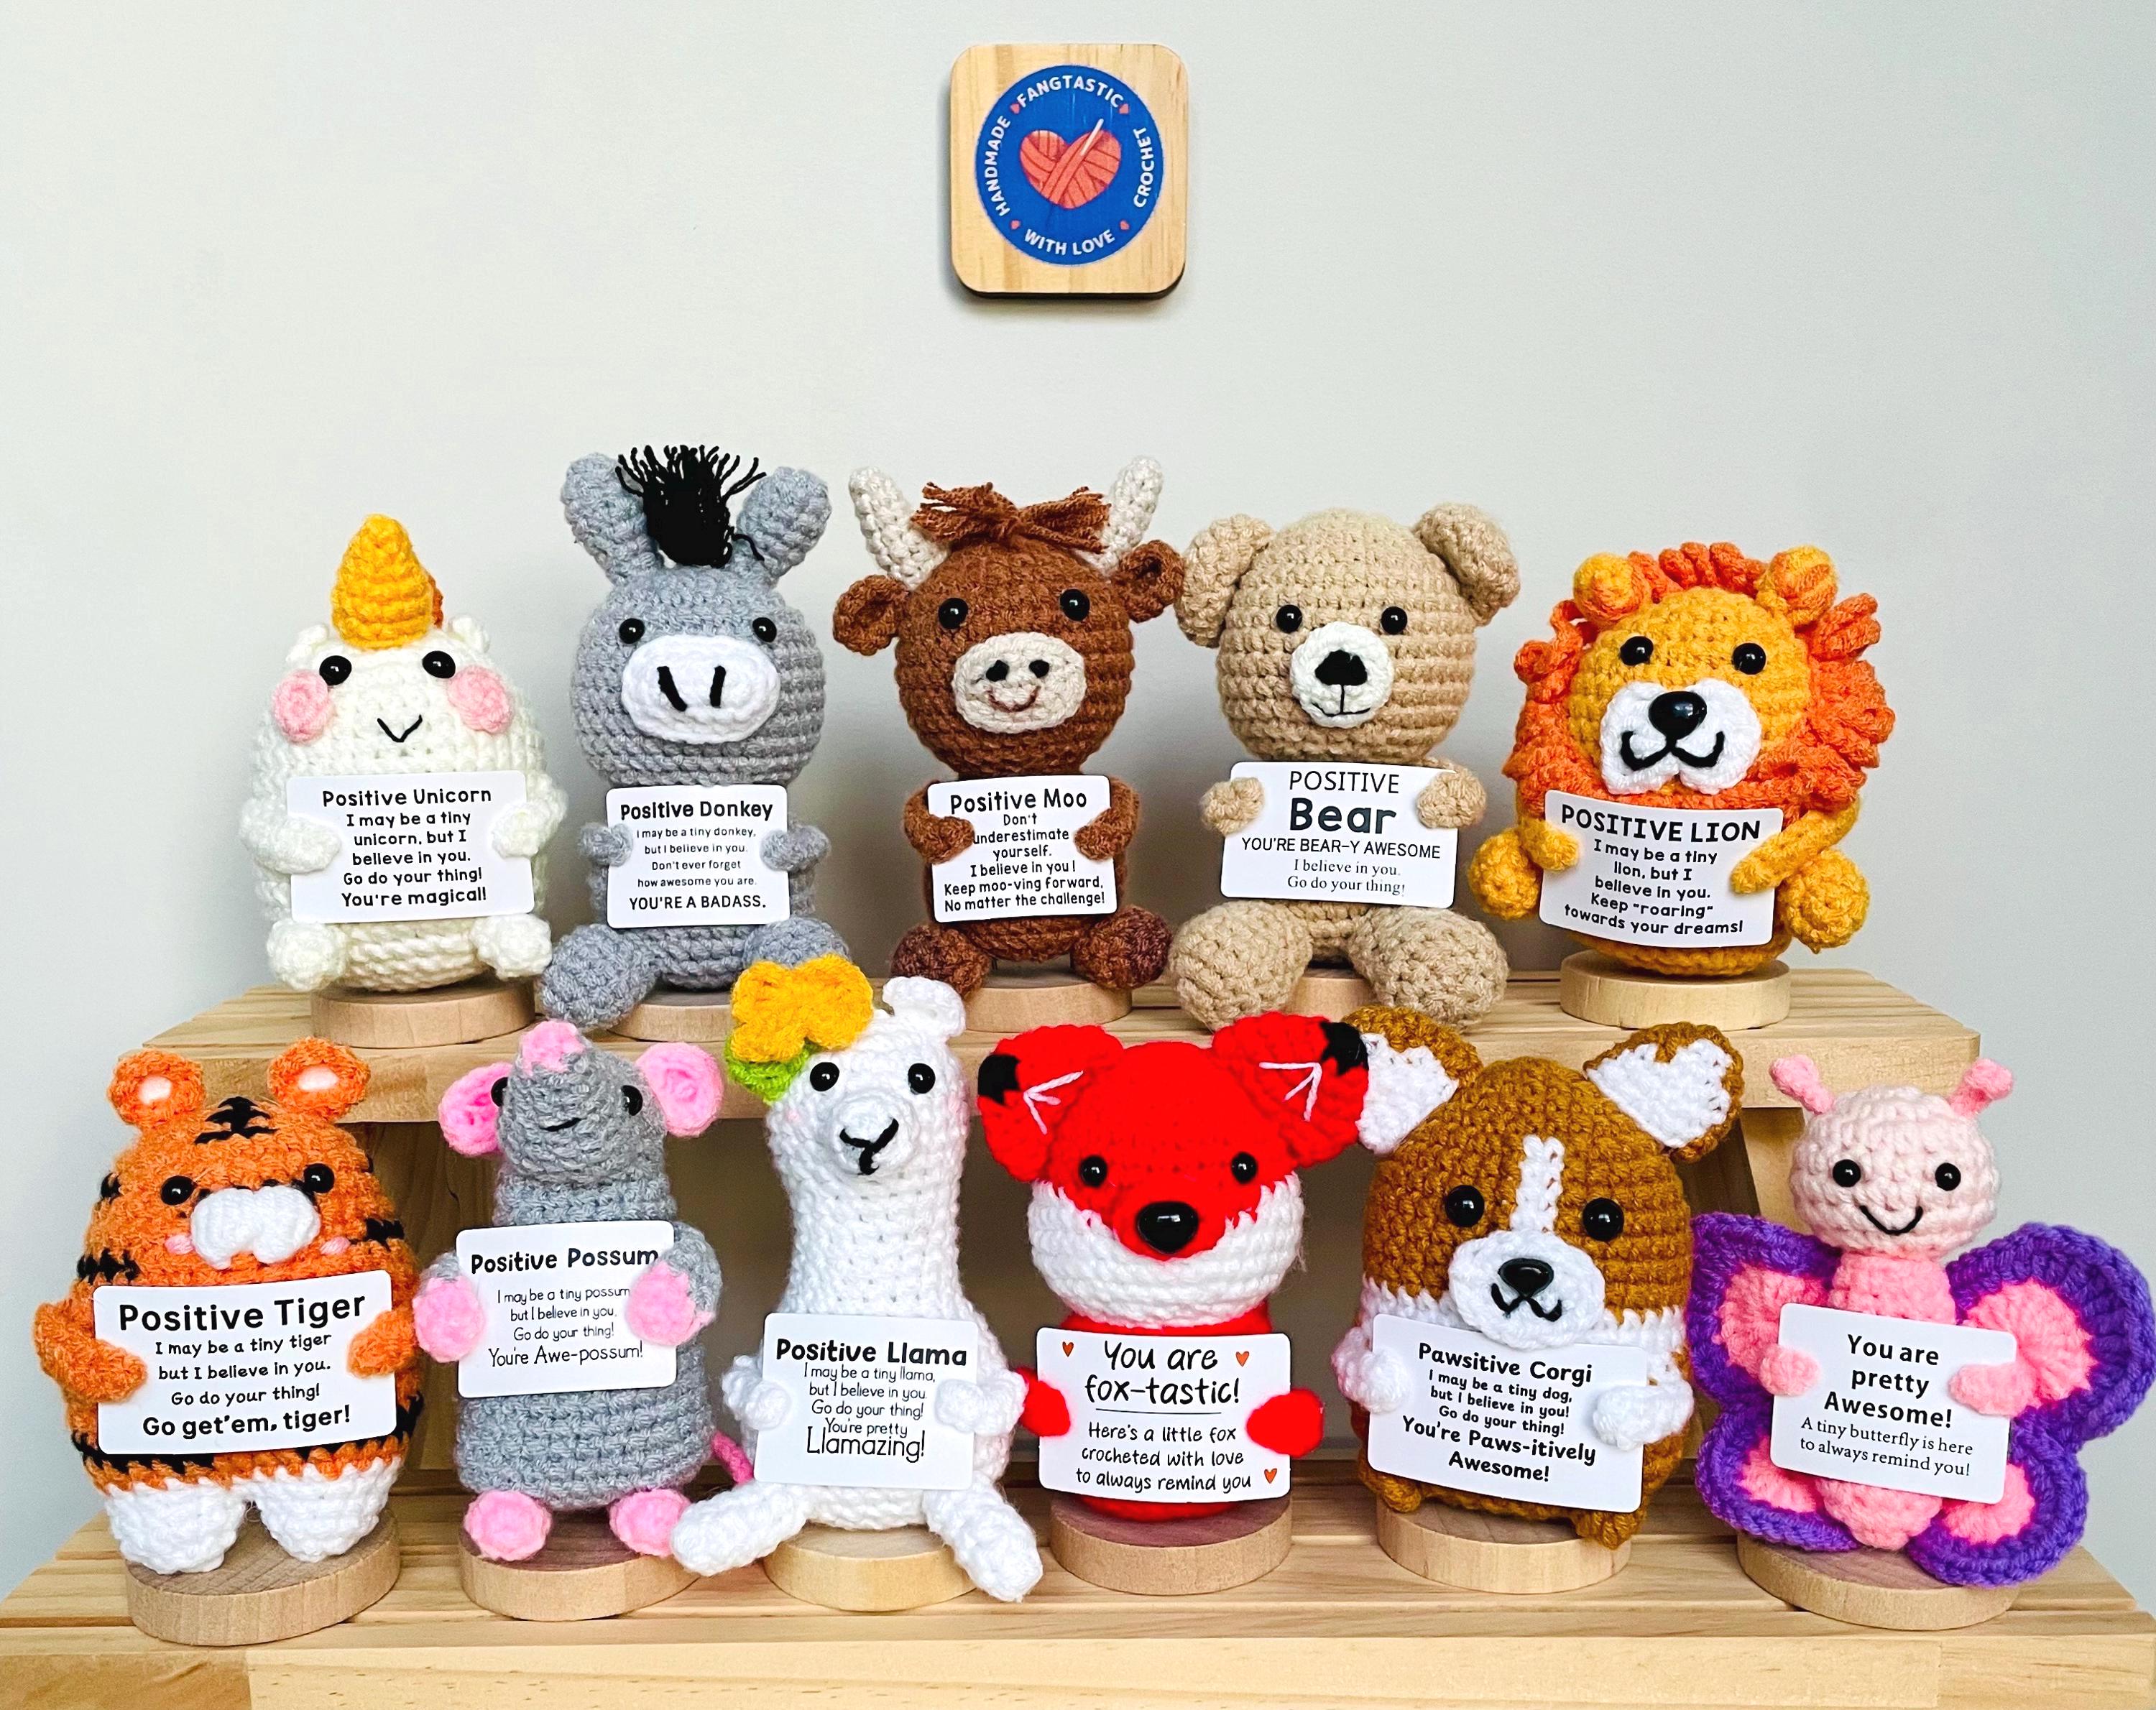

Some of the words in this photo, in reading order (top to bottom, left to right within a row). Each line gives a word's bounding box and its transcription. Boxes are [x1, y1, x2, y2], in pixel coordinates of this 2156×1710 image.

[1016, 75, 1123, 108] FANGTASTIC
[985, 116, 1010, 216] HANDMADE
[1133, 128, 1155, 208] CROCHET
[1025, 228, 1067, 255] WITH
[1072, 229, 1115, 255] LOVE
[1289, 770, 1400, 794] POSITIVE
[322, 790, 407, 808] Positive
[413, 787, 492, 805] Unicorn
[620, 800, 694, 821] Positive
[699, 800, 773, 822] Donkey
[950, 790, 1036, 815] Positive
[1044, 787, 1087, 808] Moo
[346, 813, 355, 827] I
[359, 815, 395, 829] may
[400, 812, 421, 826] be
[425, 813, 436, 825] a
[440, 810, 471, 826] tiny
[1003, 812, 1038, 826] Don't
[1289, 797, 1397, 835] Bear
[1561, 803, 1684, 842] POSITIVE
[1690, 820, 1761, 843] LION
[973, 828, 1070, 845] underestimate
[1241, 837, 1296, 851] YOU'RE
[1363, 841, 1441, 859] AWESOME
[352, 852, 414, 866] believe
[418, 851, 433, 864] in
[436, 851, 471, 866] you.
[652, 861, 680, 871] Don't
[681, 860, 708, 870] ever
[709, 859, 741, 872] forget
[992, 844, 1052, 862] yourself.
[343, 872, 363, 886] Go
[367, 872, 388, 884] do
[392, 872, 432, 887] your
[436, 866, 482, 883] thing!
[969, 864, 977, 878] I
[980, 862, 1028, 877] believe
[1031, 861, 1043, 873] in
[1650, 866, 1679, 881] but
[1682, 868, 1692, 882] I
[341, 892, 402, 907] You're
[407, 886, 487, 907] magical!
[637, 878, 660, 889] how
[660, 878, 711, 887] awesome
[714, 878, 734, 887] you
[944, 882, 977, 897] Keep
[979, 877, 1041, 893] moo-ving
[1287, 875, 1307, 888] Go
[1310, 876, 1327, 889] do
[1330, 880, 1363, 893] your
[1365, 879, 1405, 896] thing!
[1595, 874, 1652, 897] believe
[1657, 885, 1671, 899] in
[1676, 888, 1710, 902] you.
[629, 895, 683, 911] YOU'RE
[686, 895, 696, 909] A
[701, 895, 766, 909] BADASS.
[944, 899, 962, 912] No
[964, 895, 1012, 911] matter
[1015, 893, 1037, 907] the
[1040, 891, 1105, 907] challenge!
[1590, 892, 1628, 914] Keep
[1564, 903, 1626, 930] towards
[1629, 921, 1669, 934] your
[1673, 920, 1743, 935] dreams!
[471, 1251, 558, 1275] Positive
[566, 1247, 660, 1269] Possum
[119, 1303, 264, 1332] Positive
[273, 1295, 366, 1329] Tiger
[513, 1326, 532, 1341] Go
[534, 1326, 550, 1340] do
[552, 1328, 579, 1342] your
[583, 1321, 614, 1339] thing!
[487, 1346, 529, 1367] You're
[533, 1339, 643, 1366] Awe-possum!
[775, 1338, 877, 1362] Positive
[887, 1341, 967, 1367] Llama
[1104, 1340, 1156, 1371] You
[1166, 1349, 1219, 1371] are
[1847, 1334, 1894, 1360] You
[1899, 1346, 1939, 1366] are
[158, 1365, 189, 1380] but
[193, 1367, 203, 1380] I
[207, 1364, 269, 1379] believe
[274, 1362, 289, 1376] in
[293, 1360, 331, 1377] you.
[1419, 1342, 1521, 1376] Pawsitive
[1529, 1361, 1593, 1388] Corgi
[170, 1391, 194, 1406] Go
[199, 1390, 221, 1405] do
[224, 1391, 267, 1408] your
[272, 1382, 320, 1402] thing!
[1084, 1374, 1240, 1405] fox-tastic!
[1429, 1369, 1434, 1381] I
[1438, 1373, 1468, 1391] may
[1472, 1376, 1488, 1391] be
[1493, 1384, 1503, 1394] a
[1508, 1383, 1537, 1402] tiny
[1542, 1386, 1572, 1405] dog,
[1851, 1369, 1930, 1400] pretty
[811, 1398, 832, 1415] Go
[835, 1400, 852, 1415] do
[855, 1405, 885, 1419] your
[889, 1402, 924, 1421] thing!
[1430, 1385, 1453, 1402] but
[1457, 1391, 1462, 1404] I
[1467, 1392, 1515, 1412] believe
[1520, 1401, 1534, 1415] in
[1539, 1405, 1570, 1420] you!
[1823, 1391, 1952, 1429] Awesome!
[142, 1416, 176, 1436] Go
[282, 1404, 350, 1433] tiger!
[824, 1417, 862, 1434] You're
[866, 1422, 908, 1438] pretty
[1088, 1420, 1138, 1441] Here's
[1143, 1428, 1154, 1442] a
[1162, 1426, 1203, 1443] little
[1209, 1426, 1237, 1443] fox
[1439, 1405, 1458, 1419] Go
[1462, 1409, 1480, 1423] do
[1483, 1415, 1517, 1430] your
[1521, 1419, 1565, 1438] thing!
[806, 1425, 926, 1464] Llamazing!
[1402, 1415, 1461, 1443] You're
[1468, 1429, 1596, 1467] Paws-itively
[1800, 1416, 1813, 1431] A
[1817, 1420, 1848, 1440] tiny
[1850, 1423, 1920, 1451] butterfly
[1922, 1439, 1935, 1450] is
[1938, 1436, 1973, 1456] here
[1082, 1446, 1161, 1466] crocheted
[1167, 1450, 1204, 1466] with
[1211, 1451, 1244, 1466] love
[1448, 1451, 1549, 1483] Awesome!
[1800, 1438, 1815, 1451] to
[1818, 1440, 1869, 1464] always
[1871, 1453, 1930, 1471] remind
[1933, 1462, 1970, 1476] you!
[1075, 1467, 1091, 1484] to
[1095, 1471, 1151, 1494] always
[1158, 1474, 1217, 1491] remind
[1222, 1475, 1251, 1494] you
